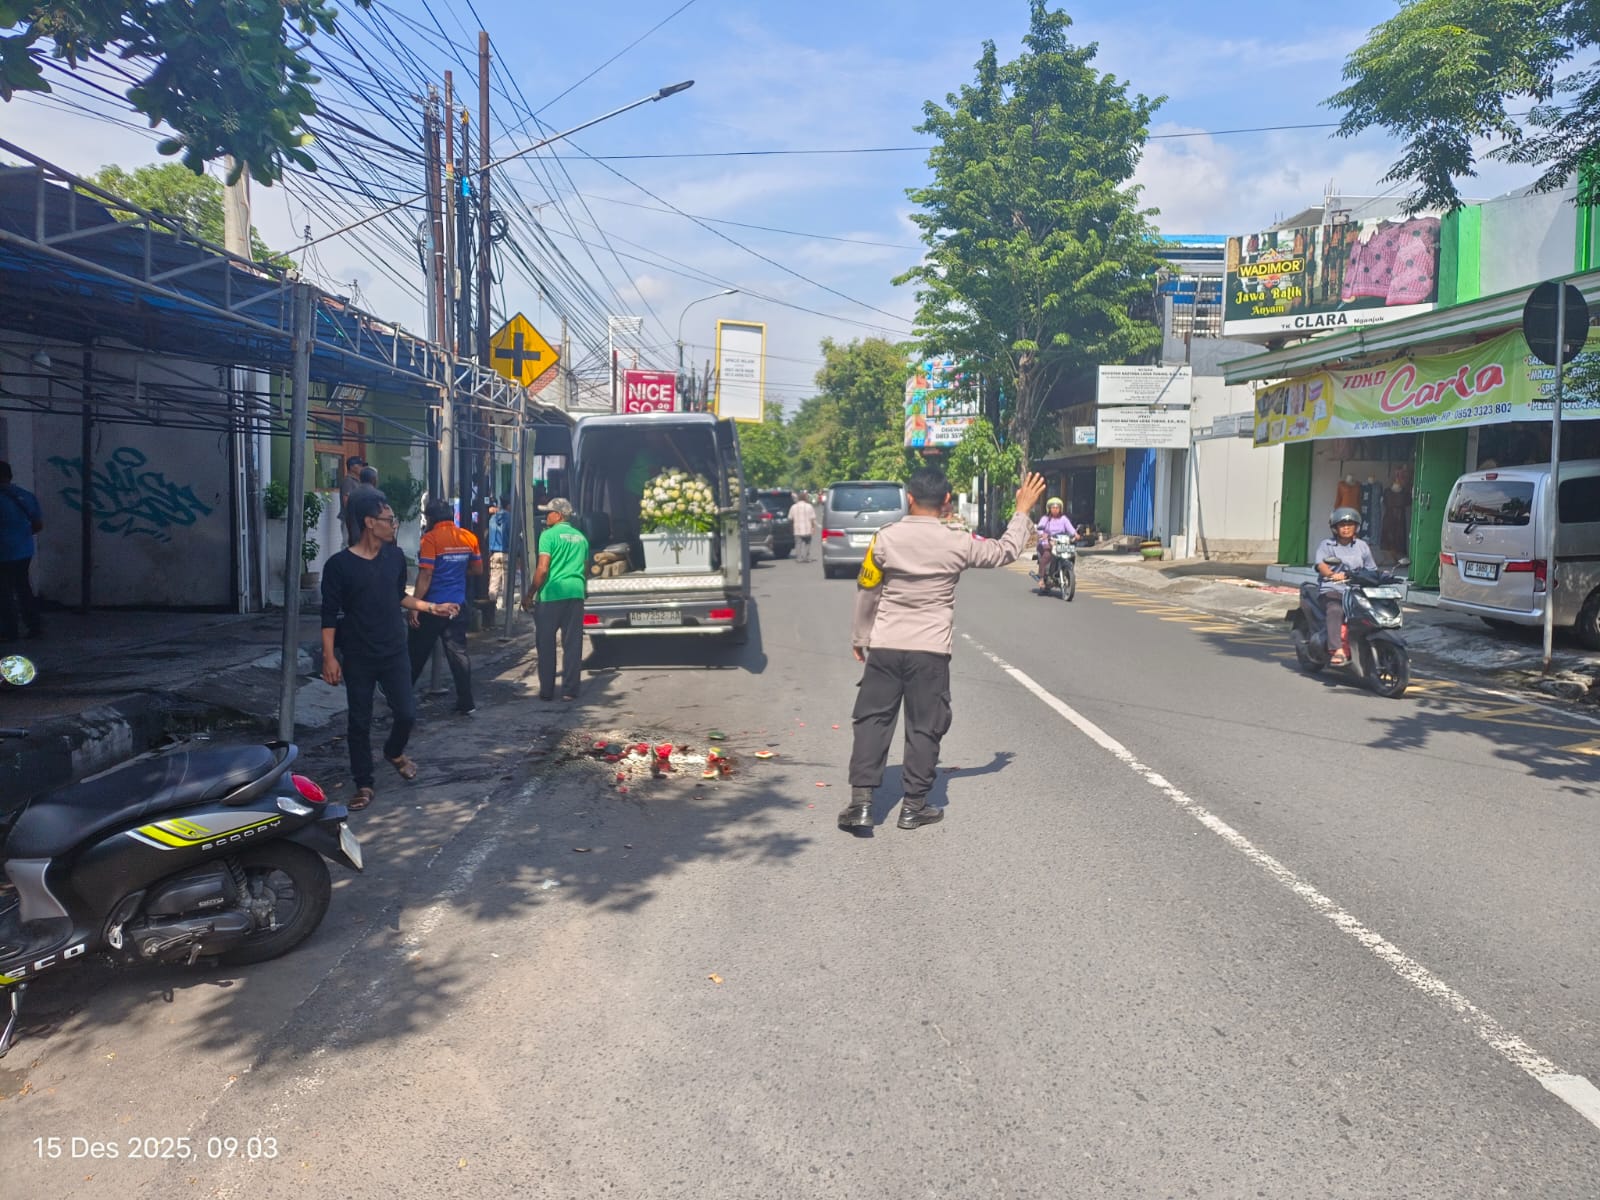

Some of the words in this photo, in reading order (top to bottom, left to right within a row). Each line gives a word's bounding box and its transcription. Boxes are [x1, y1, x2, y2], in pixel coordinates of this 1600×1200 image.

[1239, 260, 1301, 277] WADIMOR
[1235, 290, 1265, 304] Jawa
[1250, 304, 1285, 316] Anyam
[1294, 312, 1348, 329] CLARA
[1342, 370, 1387, 389] TOKO
[628, 382, 672, 401] NICE
[1401, 416, 1410, 426] 06
[201, 820, 281, 851] SCOOPY
